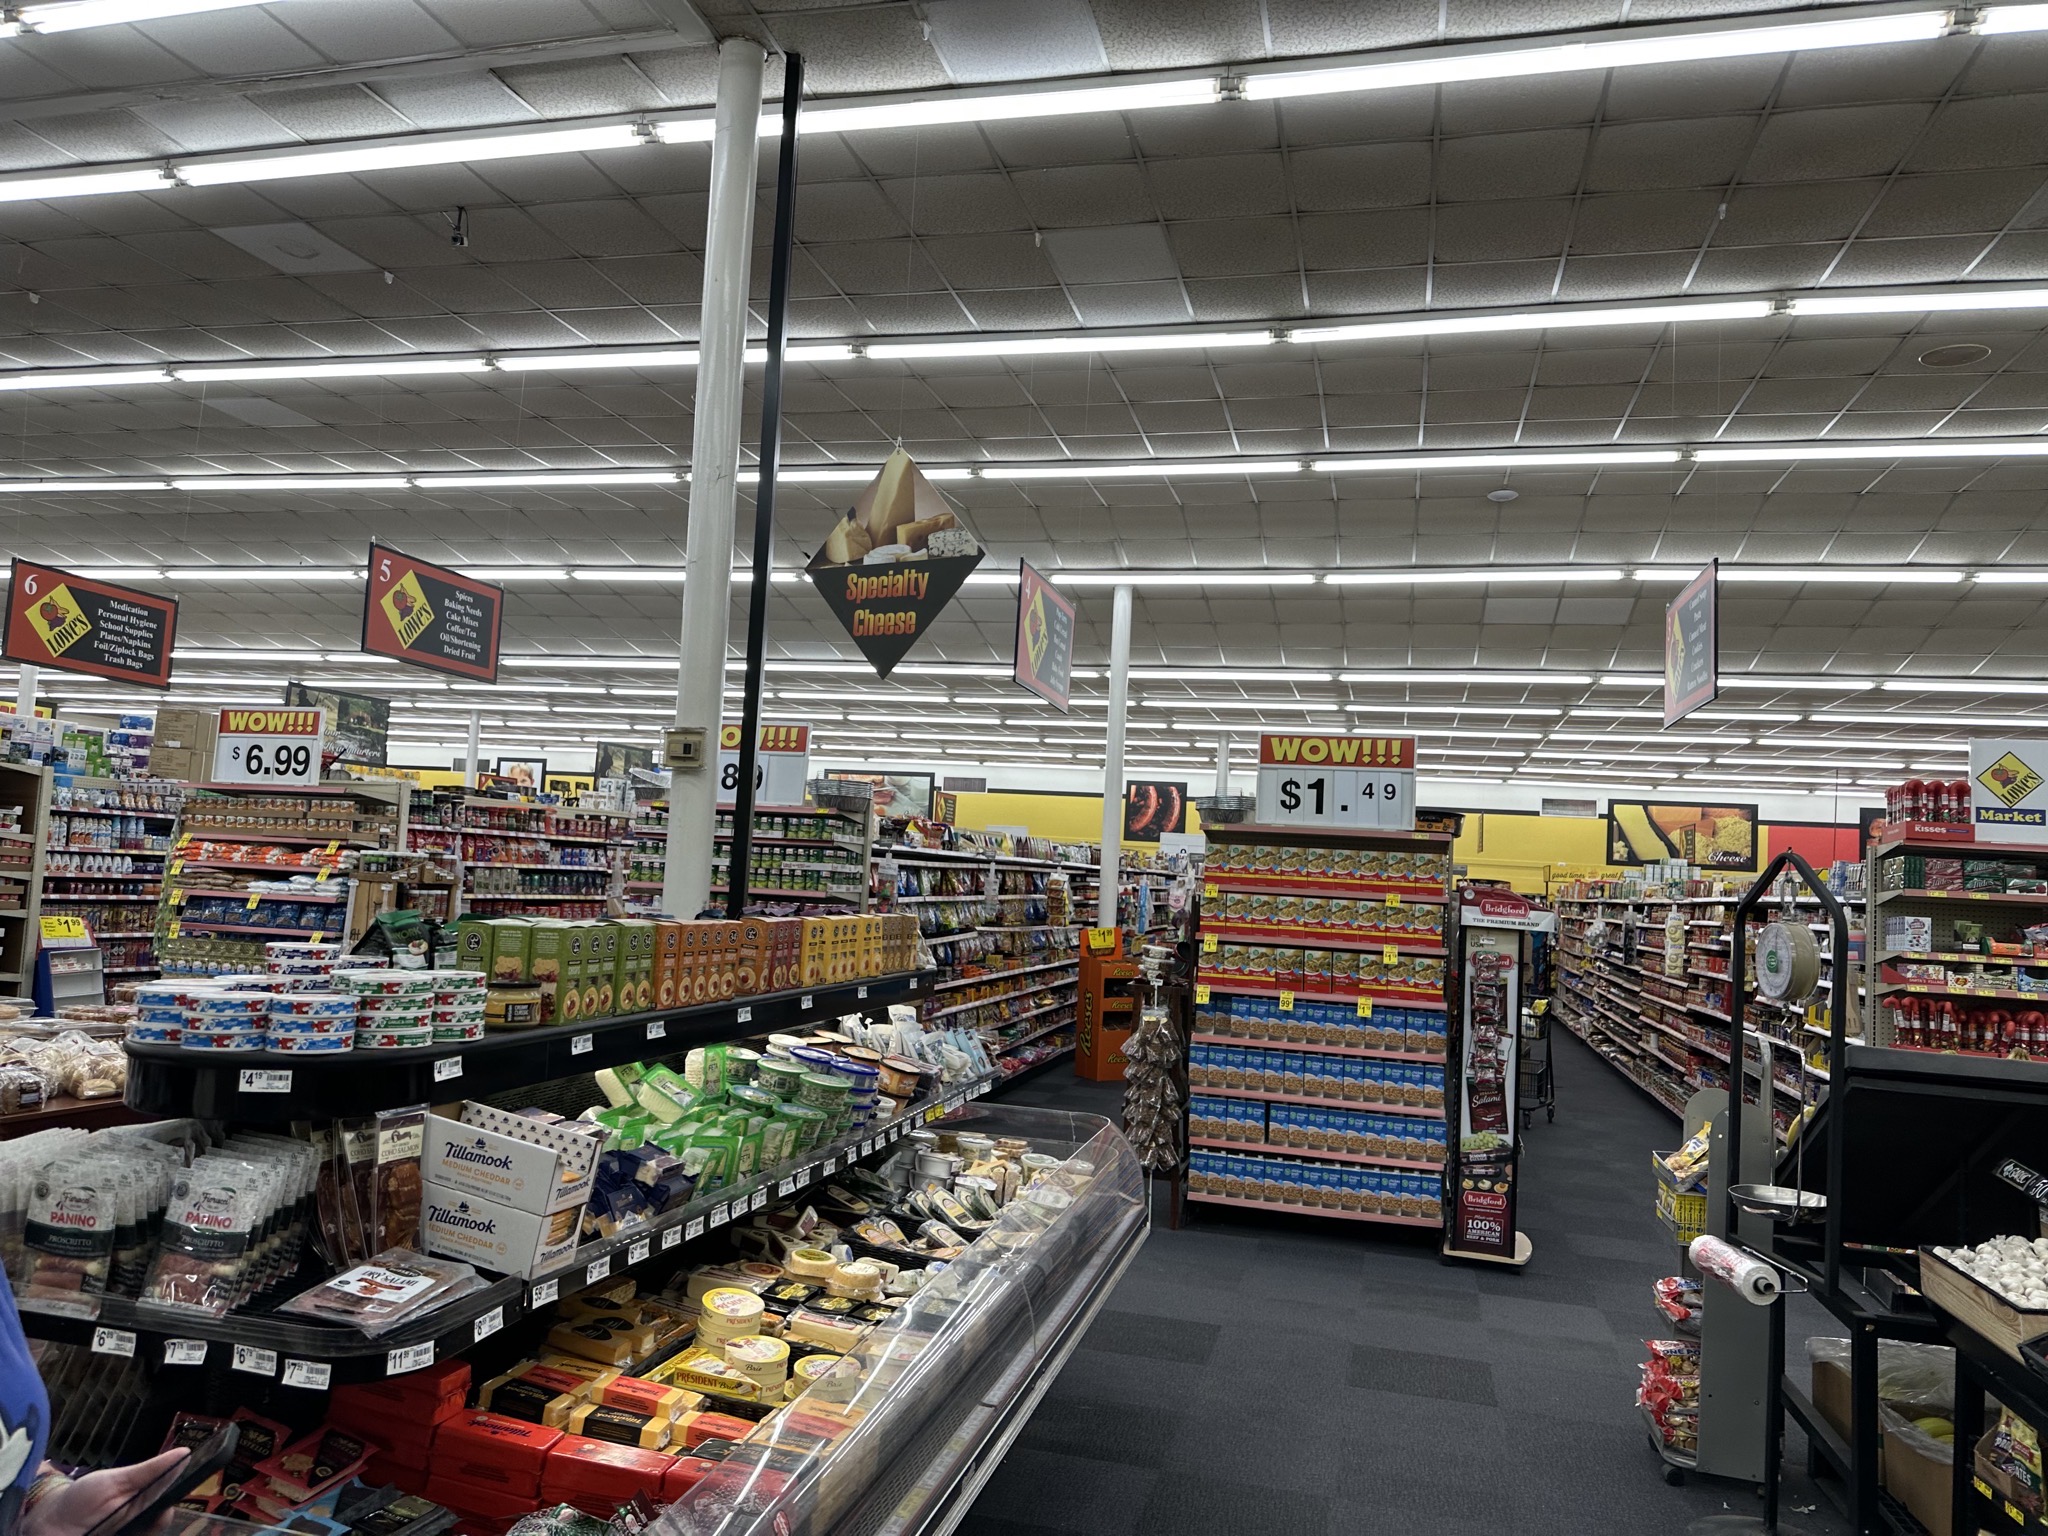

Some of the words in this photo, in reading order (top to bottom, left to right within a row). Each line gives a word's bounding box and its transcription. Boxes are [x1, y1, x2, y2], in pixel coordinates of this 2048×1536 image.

[380, 559, 392, 582] 5
[24, 574, 39, 596] 6
[846, 568, 930, 605] Specialty
[455, 590, 474, 604] Spices
[110, 600, 149, 618] Medication
[444, 598, 465, 614] Baking
[466, 604, 483, 618] Needs
[98, 608, 129, 624] Personal
[130, 616, 158, 633] Hygiene
[446, 611, 462, 624] Cake
[462, 615, 479, 628] Mixes
[852, 609, 917, 638] Cheese
[100, 620, 123, 634] School
[125, 625, 154, 641] Supplies
[446, 622, 477, 639] Coffee/Tea
[100, 631, 151, 651] Plates/Napkins
[440, 632, 481, 653] Oil/Shortening
[94, 641, 137, 659] Foil/Ziplock
[138, 650, 155, 663] Bags
[443, 645, 460, 658] Dried
[460, 649, 476, 661] Fruit
[104, 654, 124, 667] Trash
[126, 659, 143, 672] Bags
[229, 711, 315, 732] WOW!!!
[1270, 736, 1402, 765] WOW!!!
[1980, 810, 2042, 823] Market
[1707, 851, 1748, 864] Cheese
[1552, 872, 1567, 881] good
[1568, 871, 1585, 880] times
[1600, 872, 1619, 881] great
[1485, 903, 1525, 915] Bridgford
[1486, 919, 1517, 927] PREMIUM
[1472, 1093, 1502, 1108] Salami
[397, 1143, 421, 1156] SALMON
[445, 1142, 513, 1172] Tillamook
[441, 1159, 472, 1175] MEDIUM
[474, 1169, 511, 1188] CHEDDAR
[556, 1179, 591, 1201] Tillamook
[1468, 1196, 1503, 1206] Bridgford
[50, 1211, 97, 1229] PANINO
[185, 1211, 232, 1230] PANINO
[428, 1206, 496, 1236] Tillamook
[1467, 1219, 1501, 1232] 100%
[48, 1234, 92, 1247] PROSCIUTTO
[181, 1234, 225, 1249] PROSCIUTTO
[457, 1233, 493, 1251] CHEDDAR
[1467, 1229, 1501, 1238] AMERICAN
[541, 1242, 575, 1264] Tillamook
[382, 1275, 420, 1288] SALAMI
[745, 1363, 763, 1373] Brie
[467, 1419, 533, 1438] Tillamook
